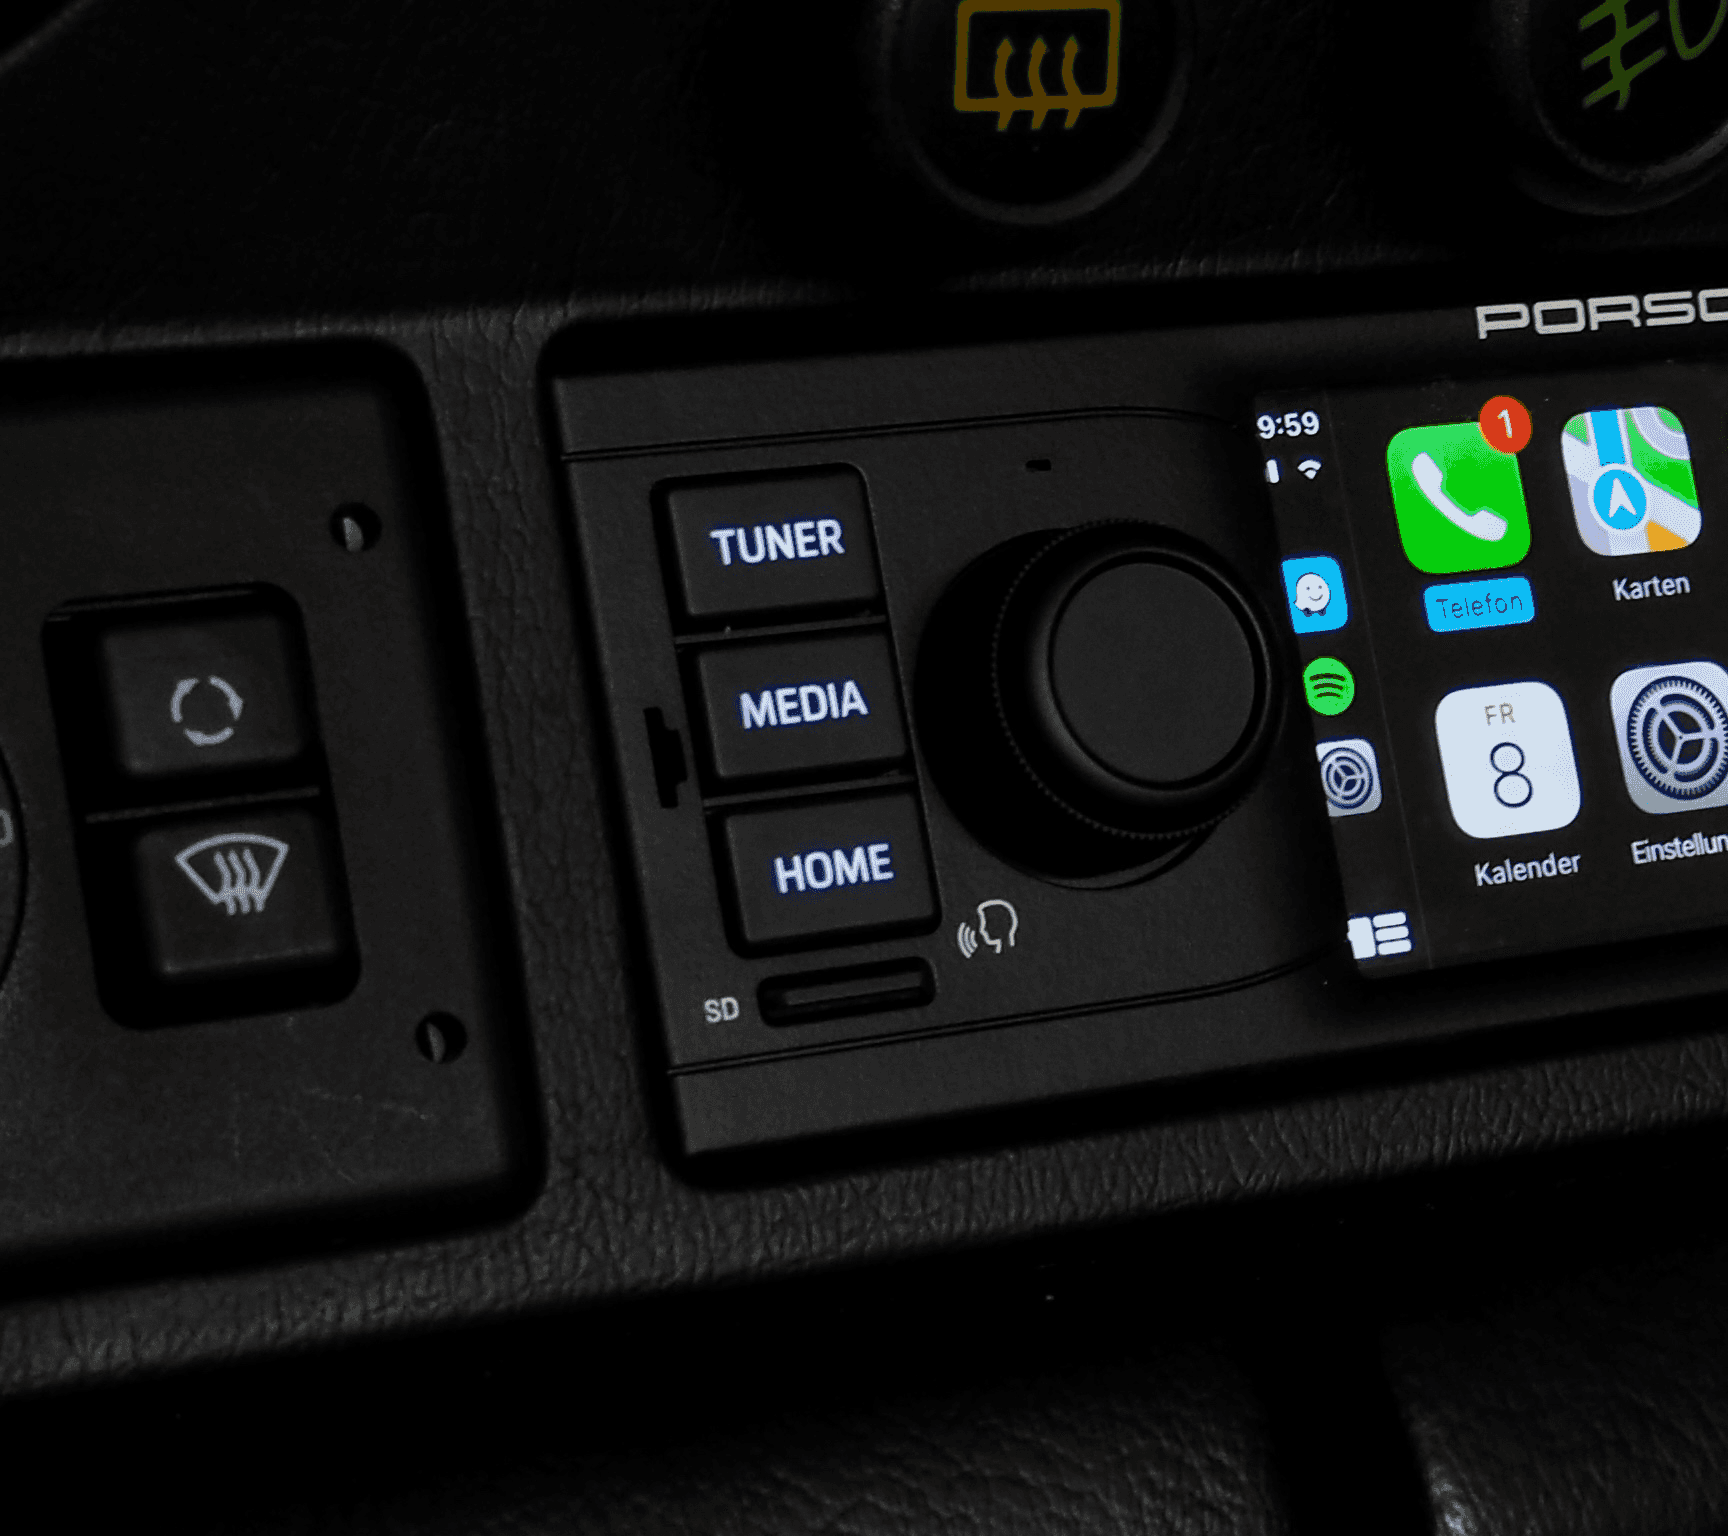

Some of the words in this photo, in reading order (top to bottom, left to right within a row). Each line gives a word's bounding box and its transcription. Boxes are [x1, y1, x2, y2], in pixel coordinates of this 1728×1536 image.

[1256, 411, 1320, 439] 9:59
[1496, 410, 1512, 438] 1
[710, 518, 846, 565] TUNER
[1612, 572, 1691, 601] Karten
[1435, 591, 1525, 619] Telefon
[739, 679, 869, 729] MEDIA
[1484, 704, 1515, 727] FR
[1489, 742, 1533, 809] 8
[773, 841, 895, 895] HOME
[1475, 852, 1581, 886] Kalender
[703, 996, 740, 1025] SD
